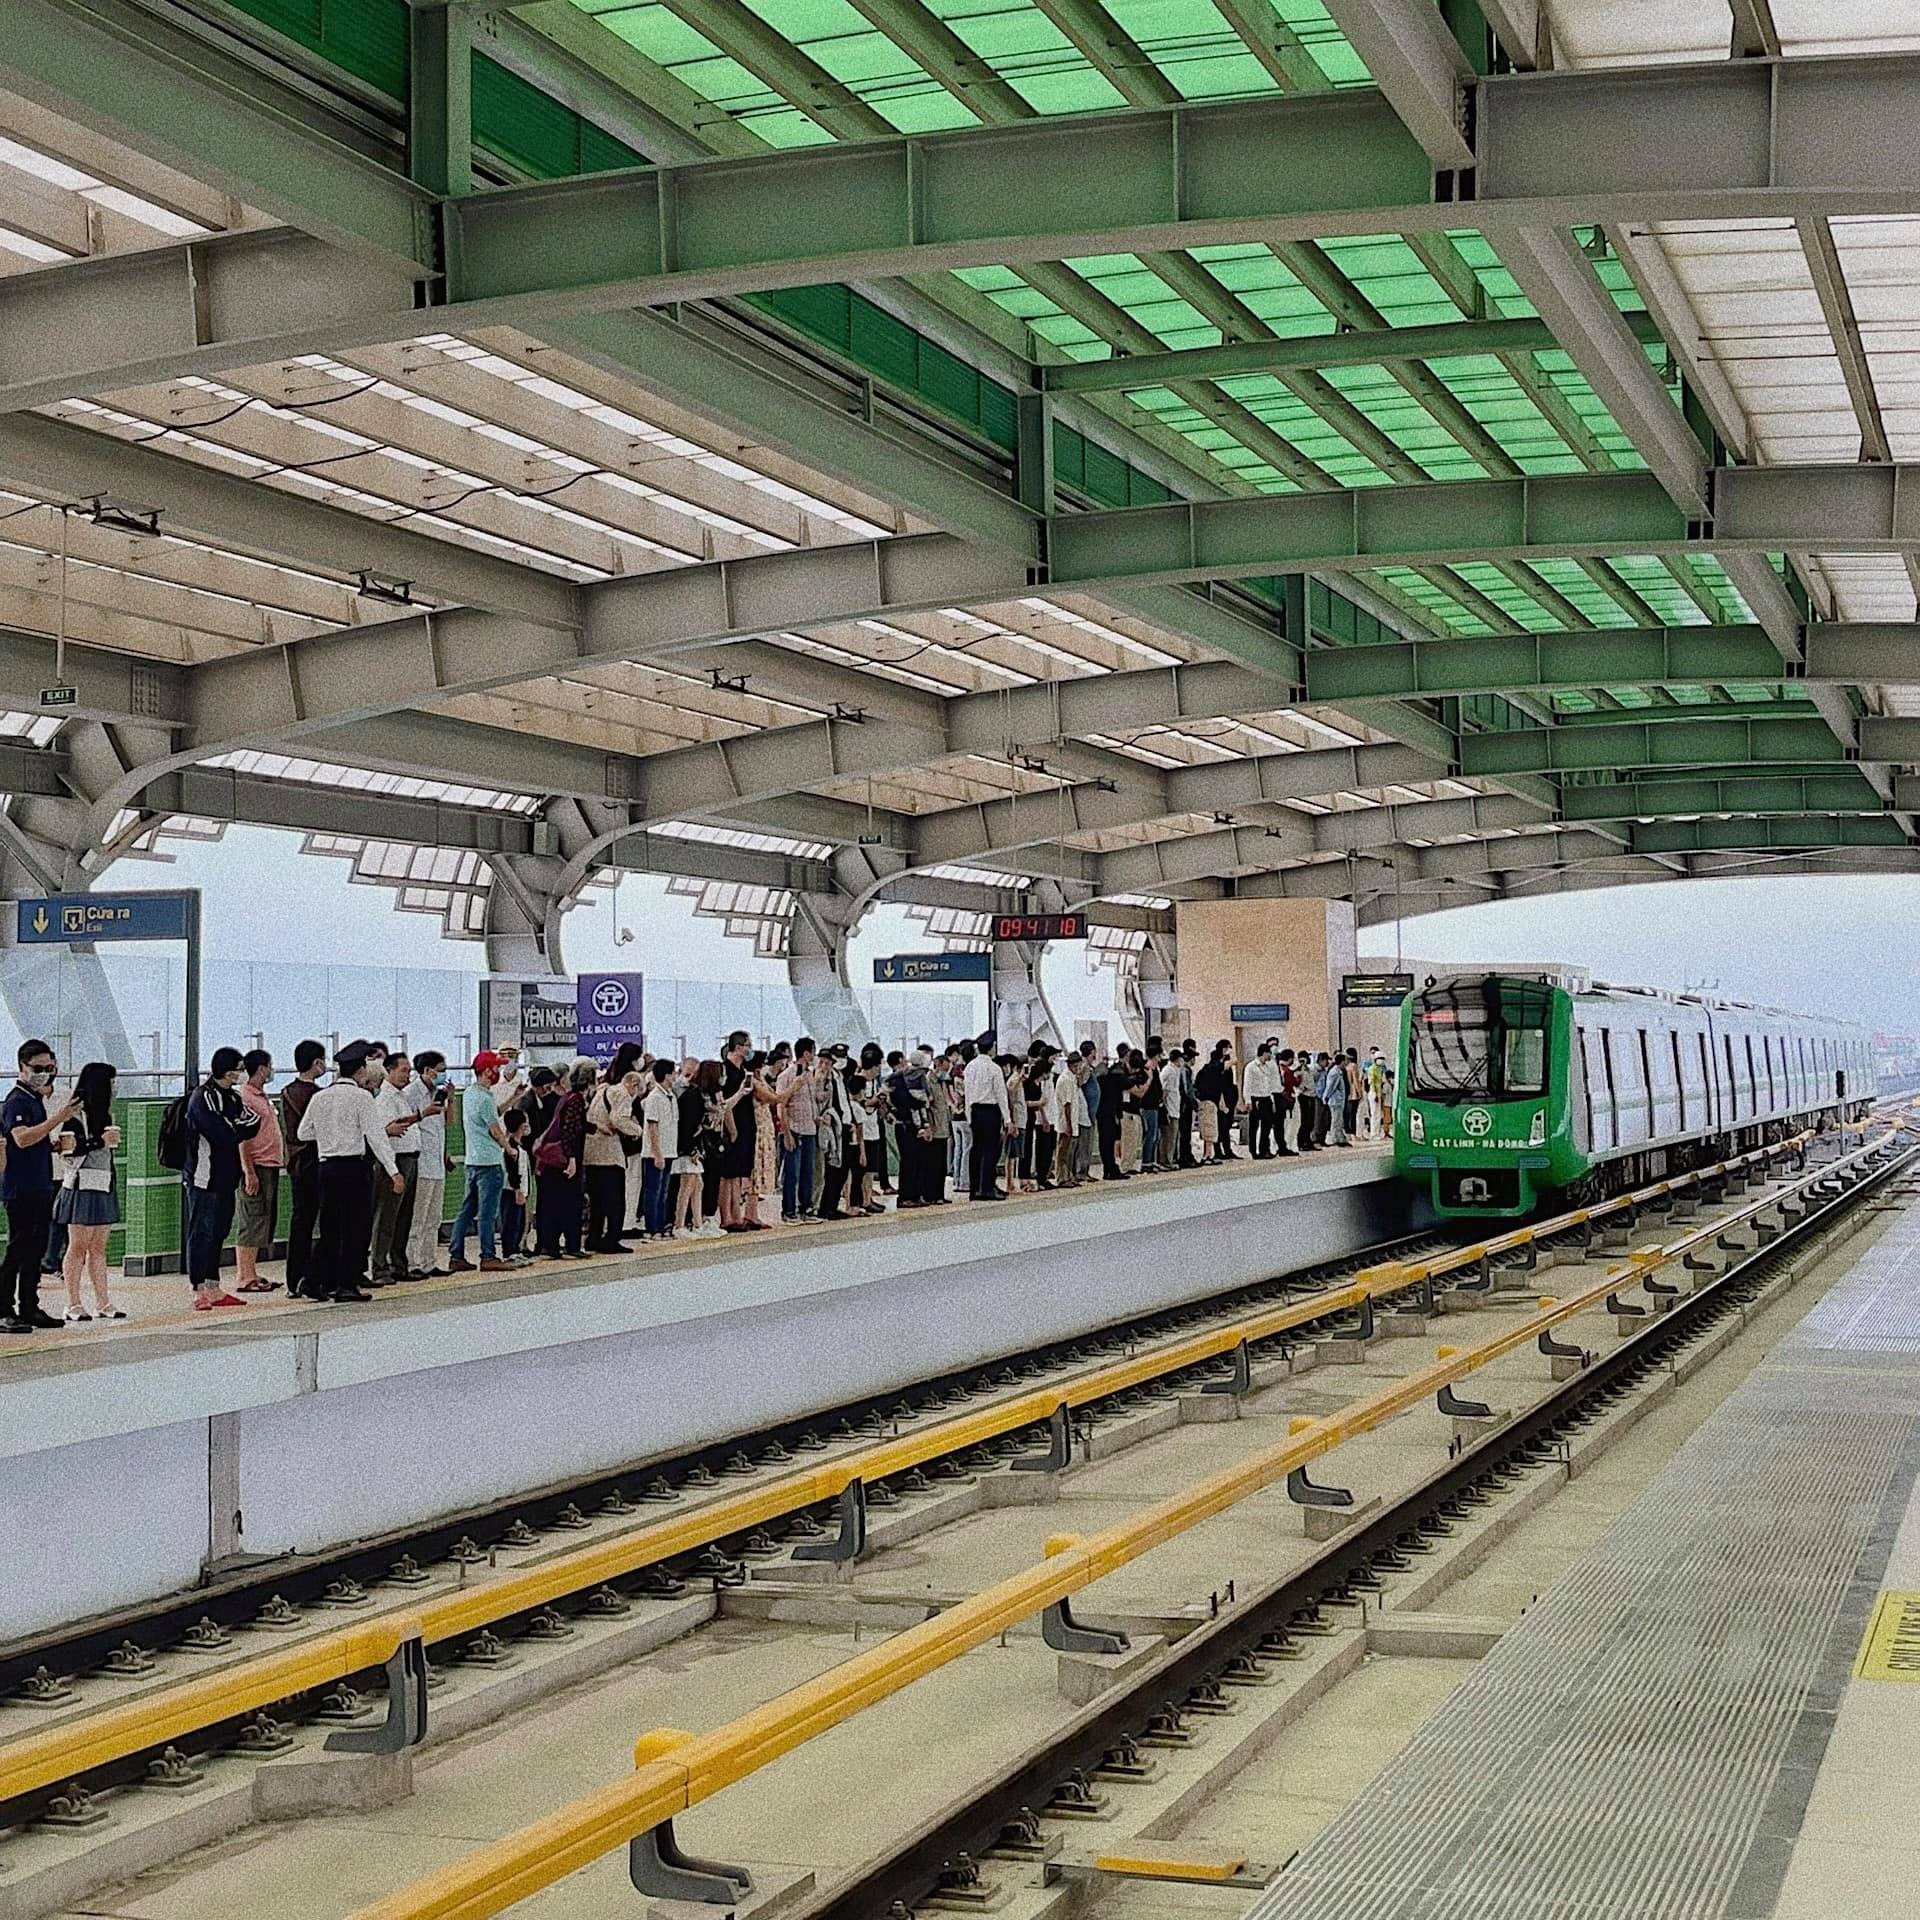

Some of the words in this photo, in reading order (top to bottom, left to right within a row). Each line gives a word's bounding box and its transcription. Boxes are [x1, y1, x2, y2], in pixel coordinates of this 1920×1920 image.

[46, 690, 71, 700] EXIT
[117, 907, 130, 919] ra
[940, 962, 950, 970] ra
[523, 1004, 545, 1028] YÊN
[615, 1024, 641, 1034] GIAO
[1453, 1139, 1475, 1148] LINH
